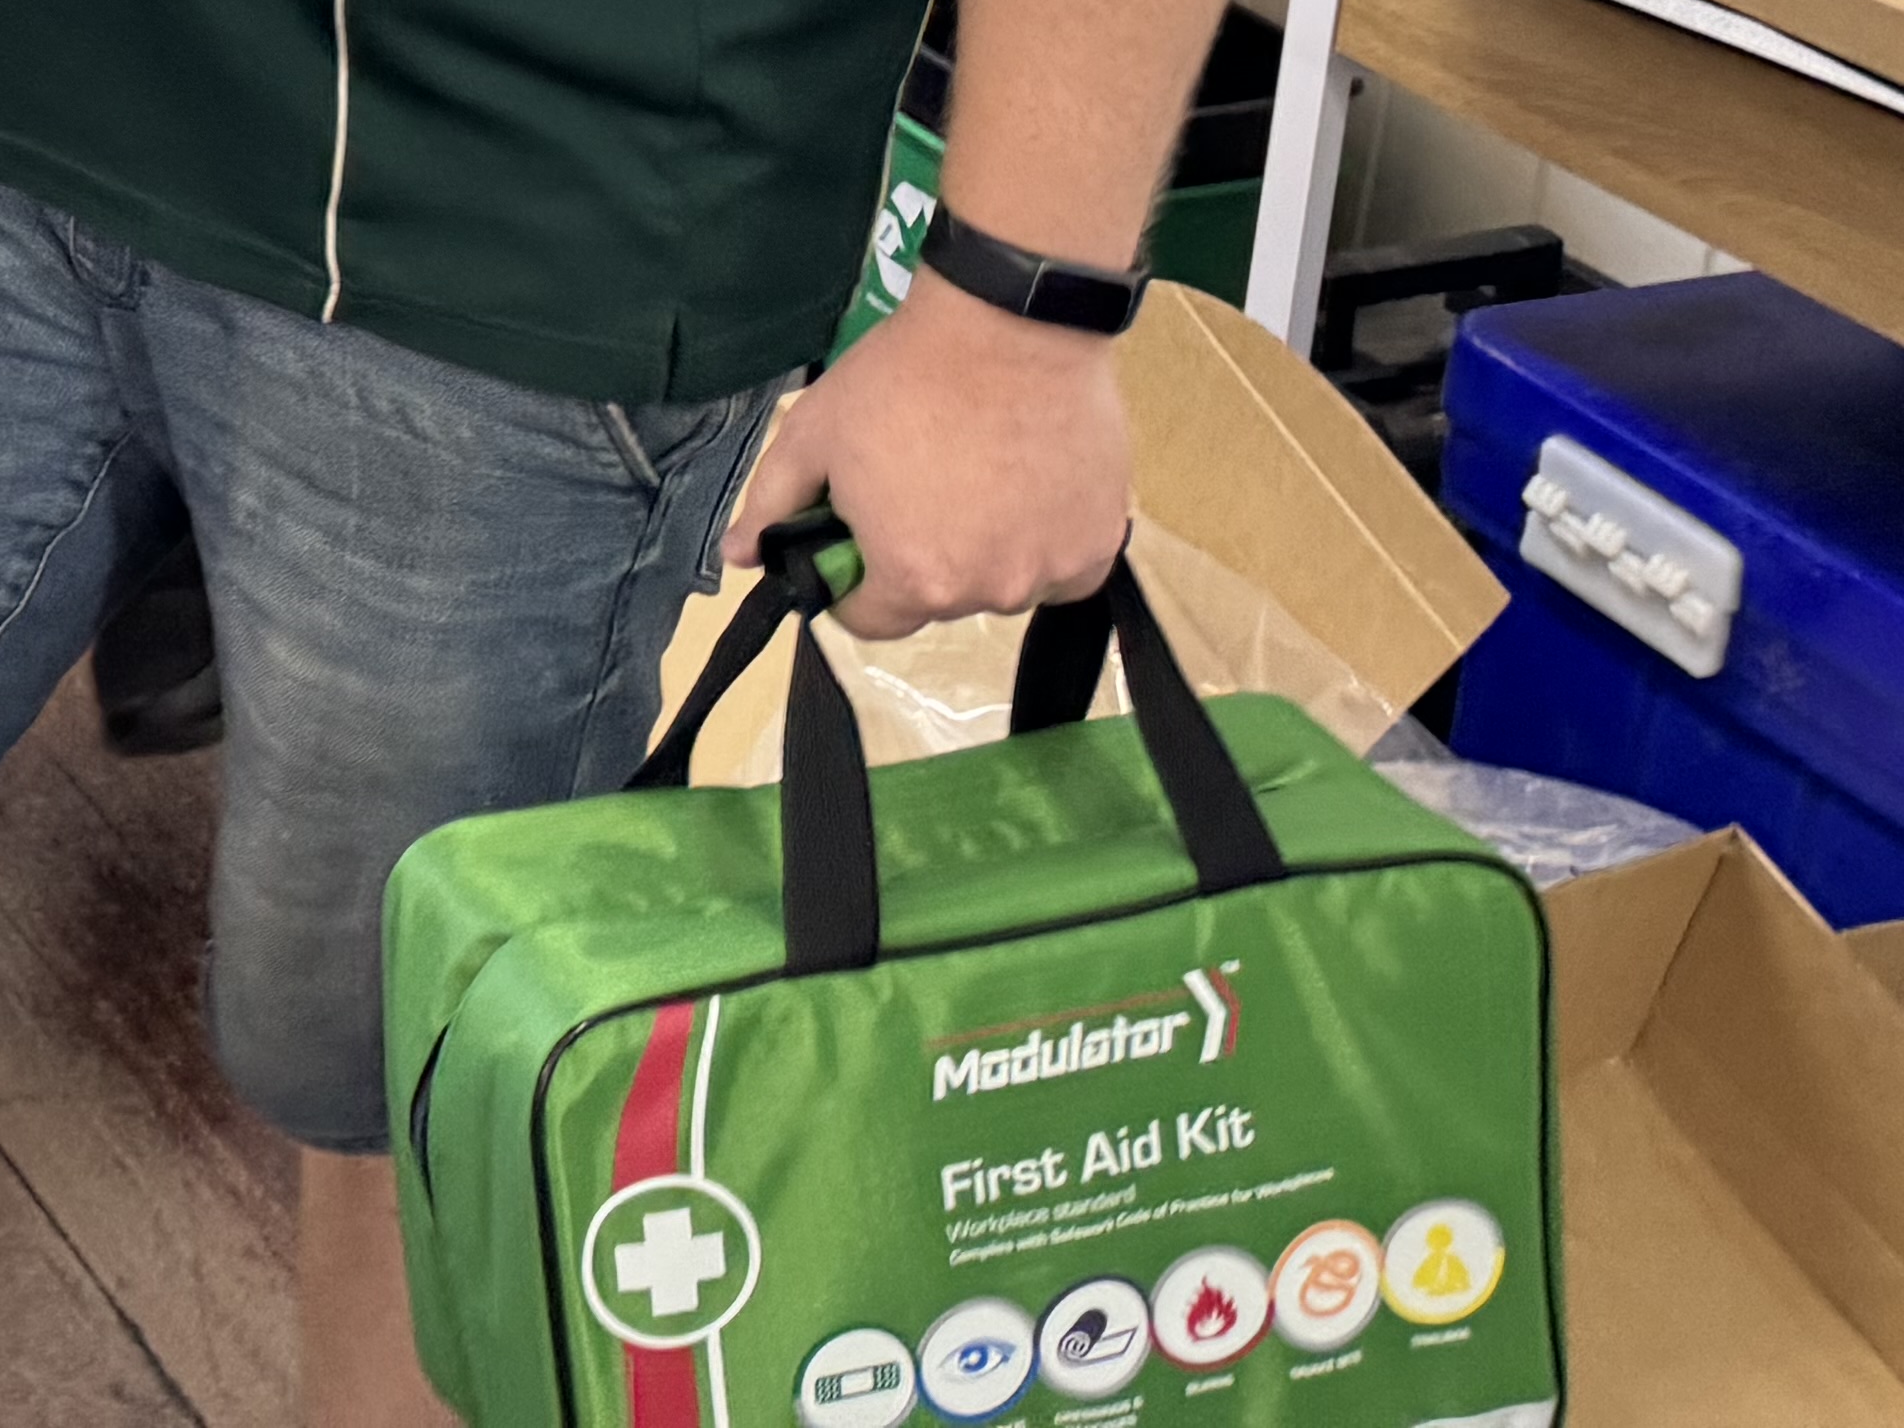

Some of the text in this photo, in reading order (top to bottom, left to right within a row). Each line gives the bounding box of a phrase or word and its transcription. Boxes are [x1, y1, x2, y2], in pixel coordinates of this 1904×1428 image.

[932, 1010, 1192, 1102] Modulator
[940, 1104, 1257, 1212] First Aid Kit
